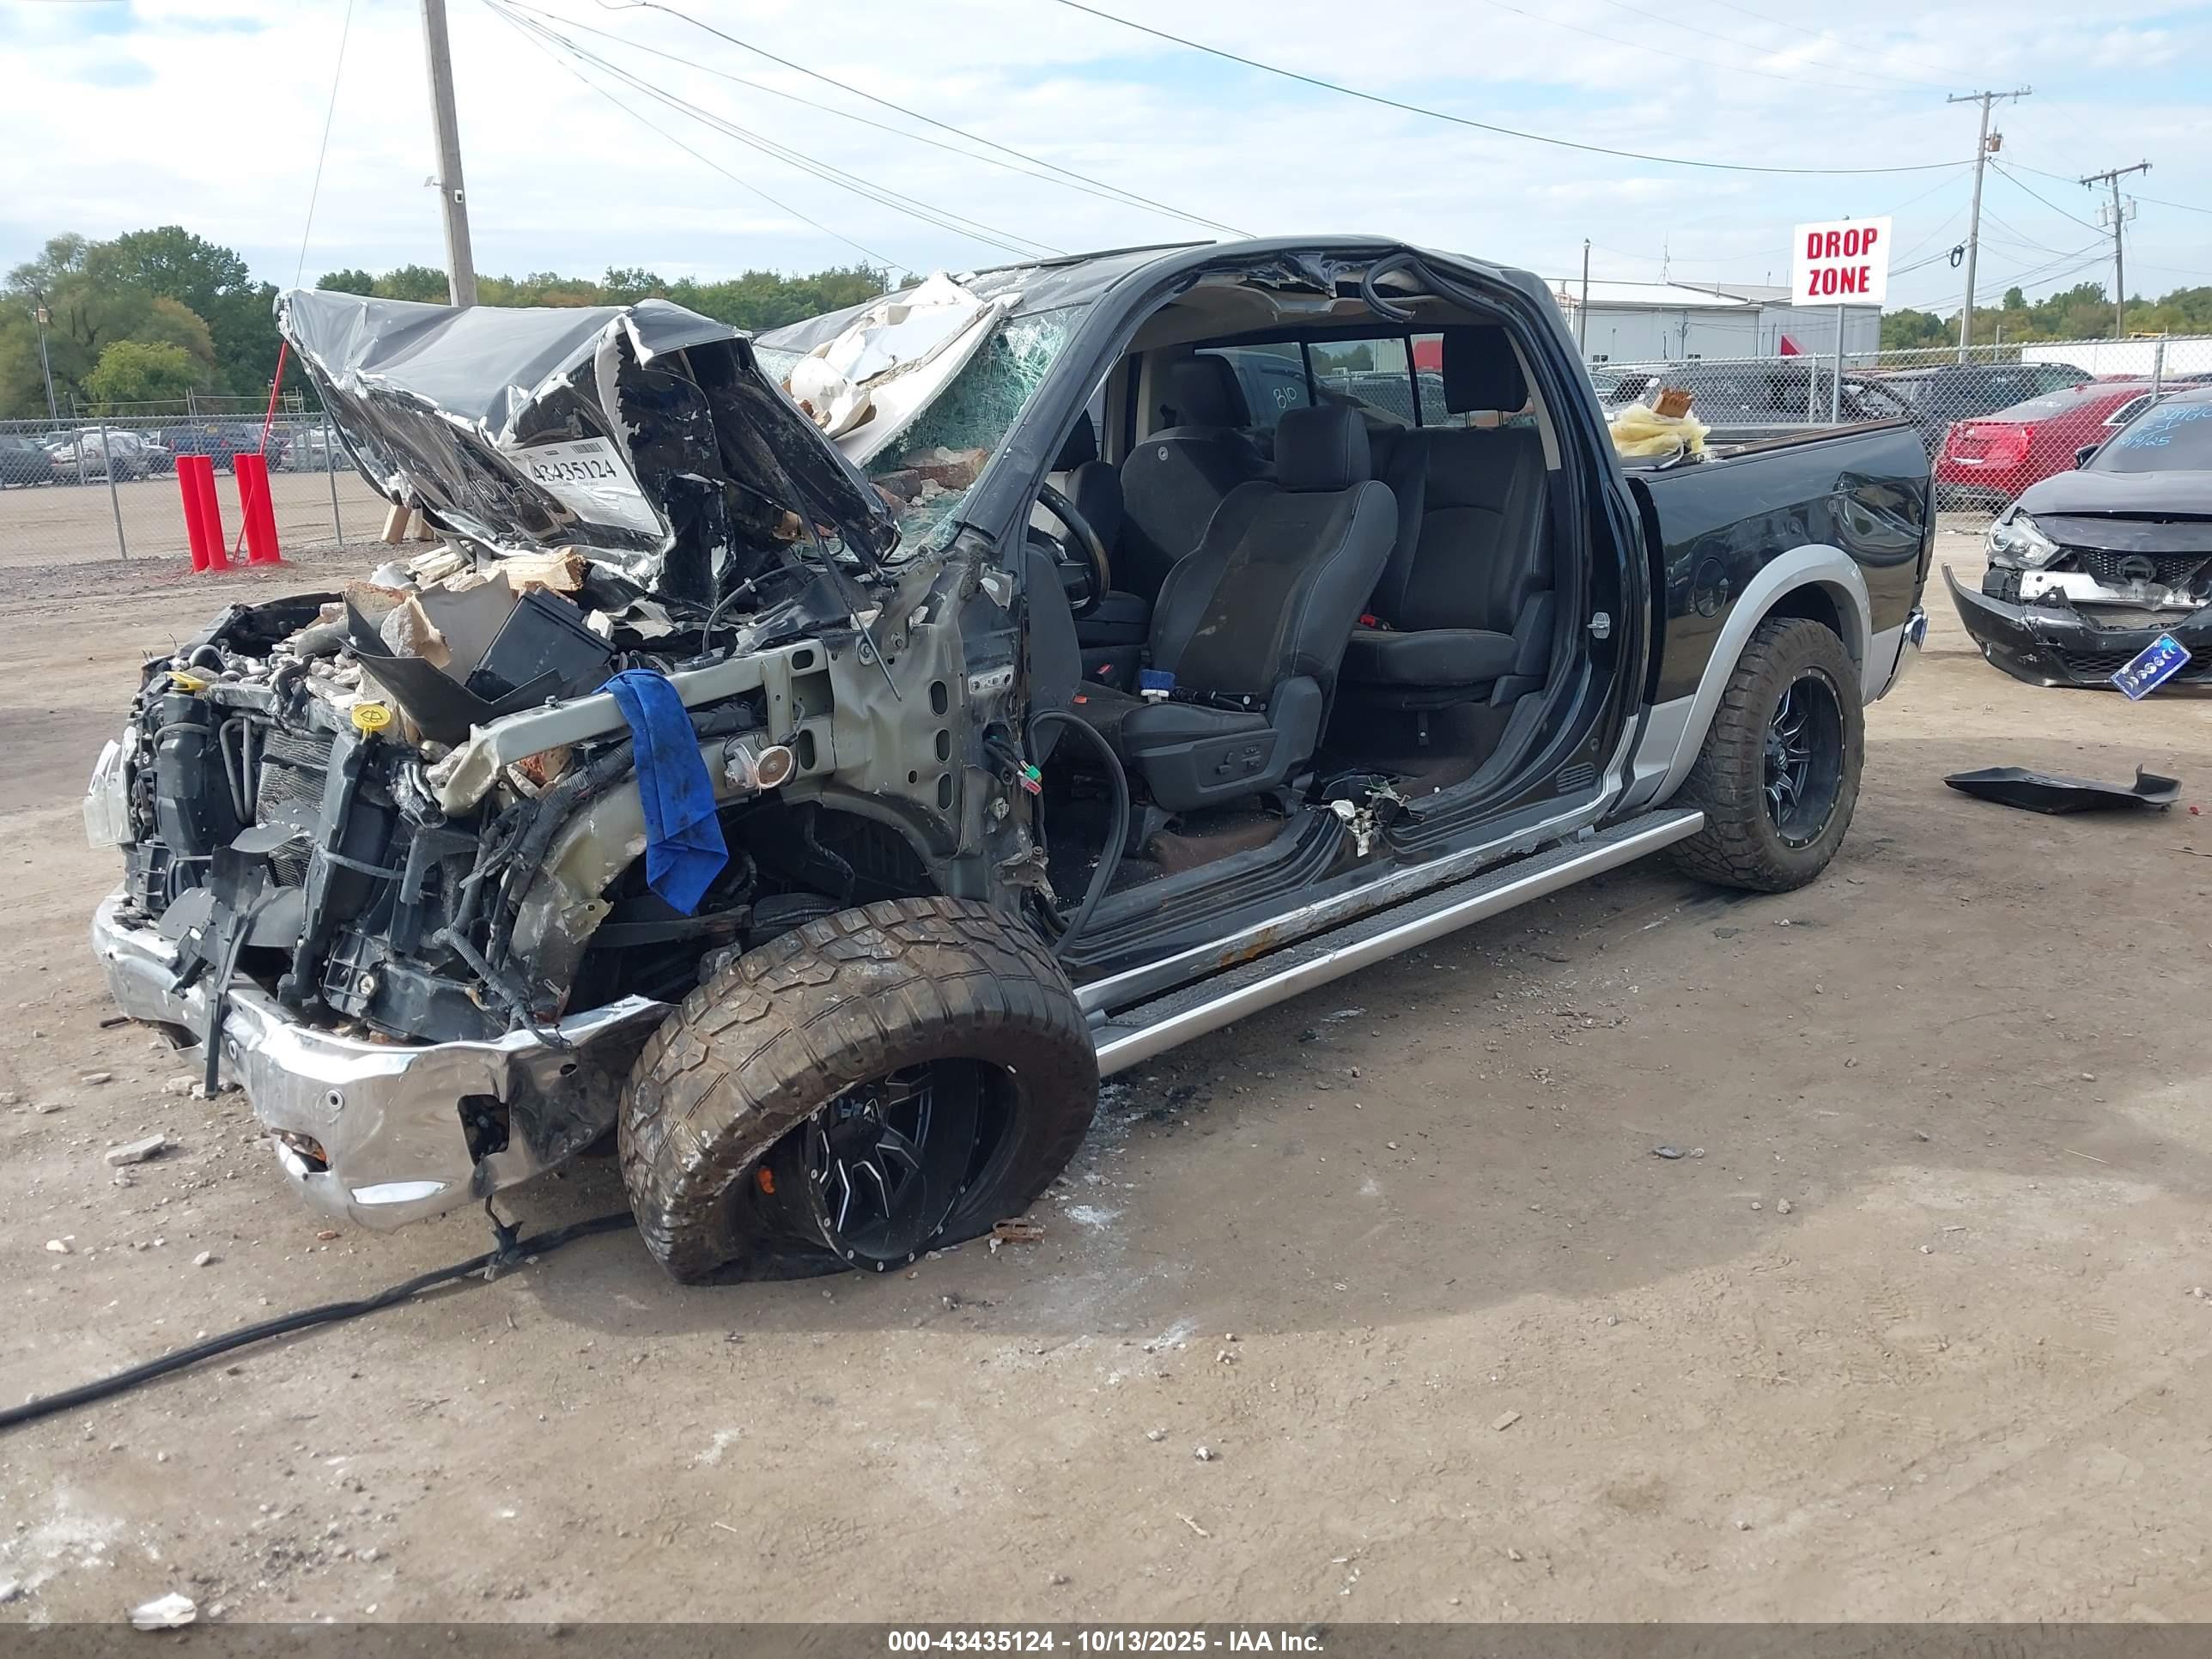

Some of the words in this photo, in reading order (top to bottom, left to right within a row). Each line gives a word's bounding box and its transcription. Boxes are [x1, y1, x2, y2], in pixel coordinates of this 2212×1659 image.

[1807, 228, 1878, 260] DROP
[1808, 265, 1871, 296] ZONE
[532, 459, 617, 483] 43435124
